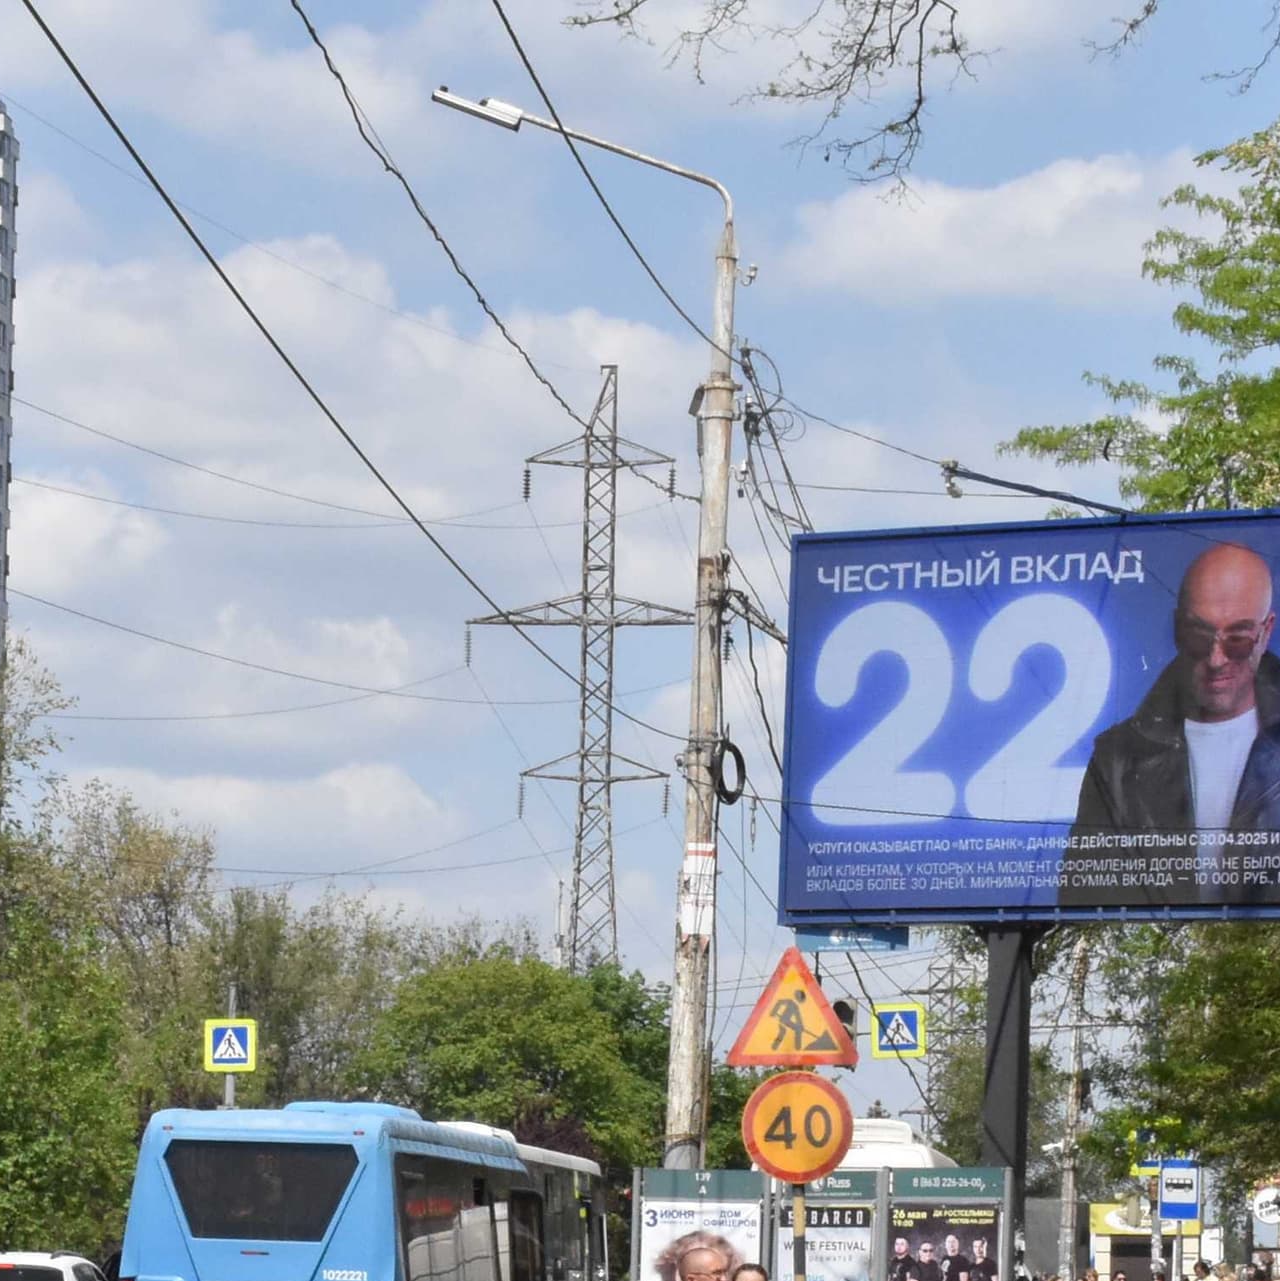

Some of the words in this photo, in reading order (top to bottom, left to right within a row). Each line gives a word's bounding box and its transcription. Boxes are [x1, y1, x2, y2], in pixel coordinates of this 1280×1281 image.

[817, 551, 1001, 594] ЧЕСТНЫЙ
[1010, 550, 1145, 585] ВКЛАД
[808, 841, 852, 854] УСЛУГИ
[854, 840, 926, 853] ОКАЗЫВАЕТ
[927, 839, 951, 851] ПАО
[1027, 836, 1079, 850] ДАННЫЕ
[1080, 833, 1186, 849] ДЕЙСТВИТЕЛЬНЫ
[1188, 834, 1198, 846] С
[1200, 832, 1268, 846] 30.04.2025
[1271, 832, 1280, 844] И
[806, 865, 832, 878] ИЛИ
[836, 863, 902, 878] КЛИЕНТАМ,
[906, 863, 916, 875] У
[917, 862, 974, 876] КОТОРЫХ
[977, 861, 995, 873] НА
[998, 860, 1051, 873] МОМЕНТ
[1056, 858, 1146, 873] ОФОРМЛЕНИЯ
[1149, 857, 1218, 872] ДОГОВОРА
[1222, 856, 1238, 869] НЕ
[1243, 856, 1280, 869] БЫЛО
[806, 878, 864, 892] ВКЛАДОВ
[867, 878, 906, 890] БОЛЕЕ
[911, 878, 927, 890] 30
[930, 876, 967, 890] ДНЕЙ.
[970, 875, 1068, 889] МИНИМАЛЬНАЯ
[1072, 874, 1118, 887] СУММА
[1123, 873, 1173, 887] ВКЛАДА
[1195, 873, 1208, 885] 10
[1212, 872, 1239, 885] 000
[764, 1105, 832, 1149] 40
[645, 1209, 657, 1227] 3
[660, 1210, 694, 1219] ИЮНЯ
[720, 1210, 741, 1218] ДОМ
[788, 1211, 864, 1225] EBARGO
[704, 1219, 757, 1228] ОФИЦЕРОВ
[784, 1242, 815, 1251] WTE
[820, 1242, 865, 1251] FESTIVAL
[323, 1270, 368, 1281] 1022221
